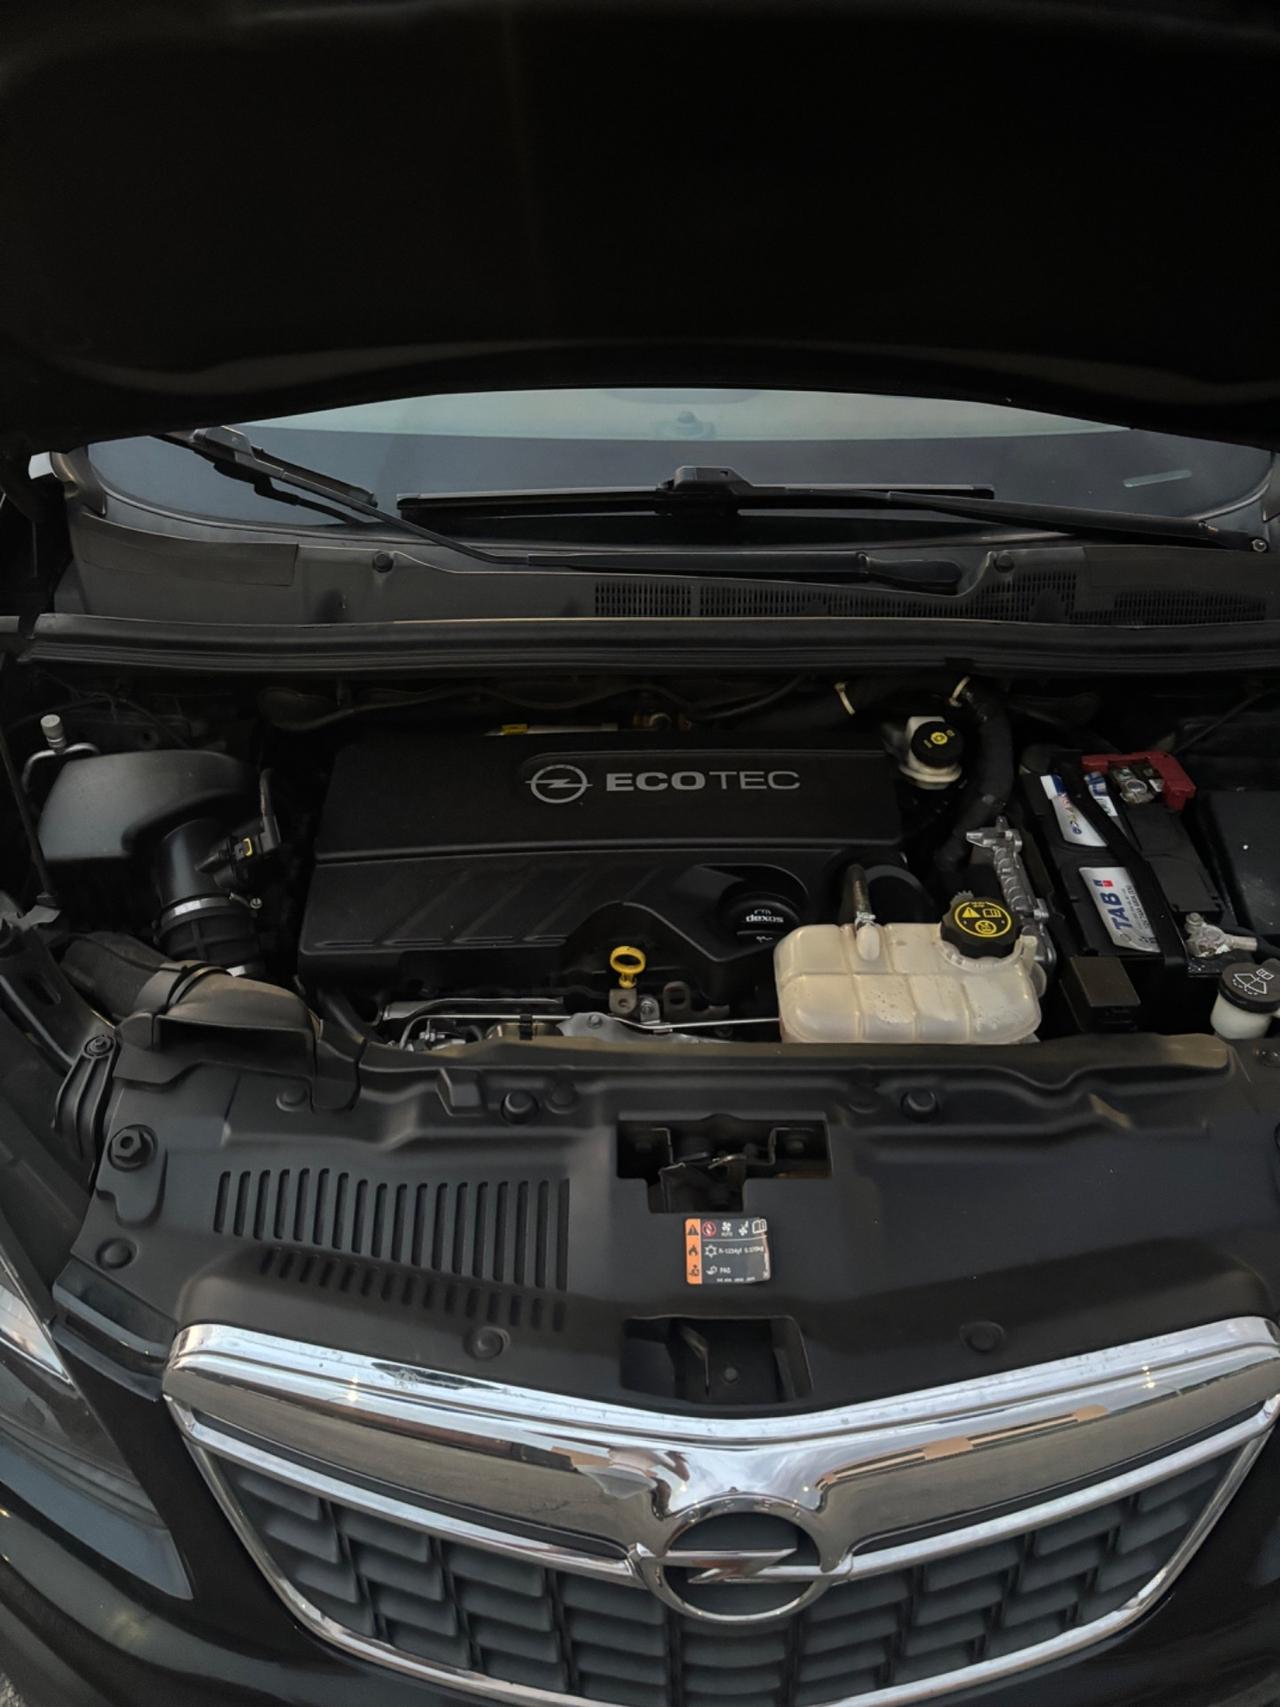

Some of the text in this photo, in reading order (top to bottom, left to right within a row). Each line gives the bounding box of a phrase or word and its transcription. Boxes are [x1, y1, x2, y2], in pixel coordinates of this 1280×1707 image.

[606, 771, 801, 792] ECOTEC
[745, 914, 785, 924] dexos
[1100, 892, 1133, 930] TAB
